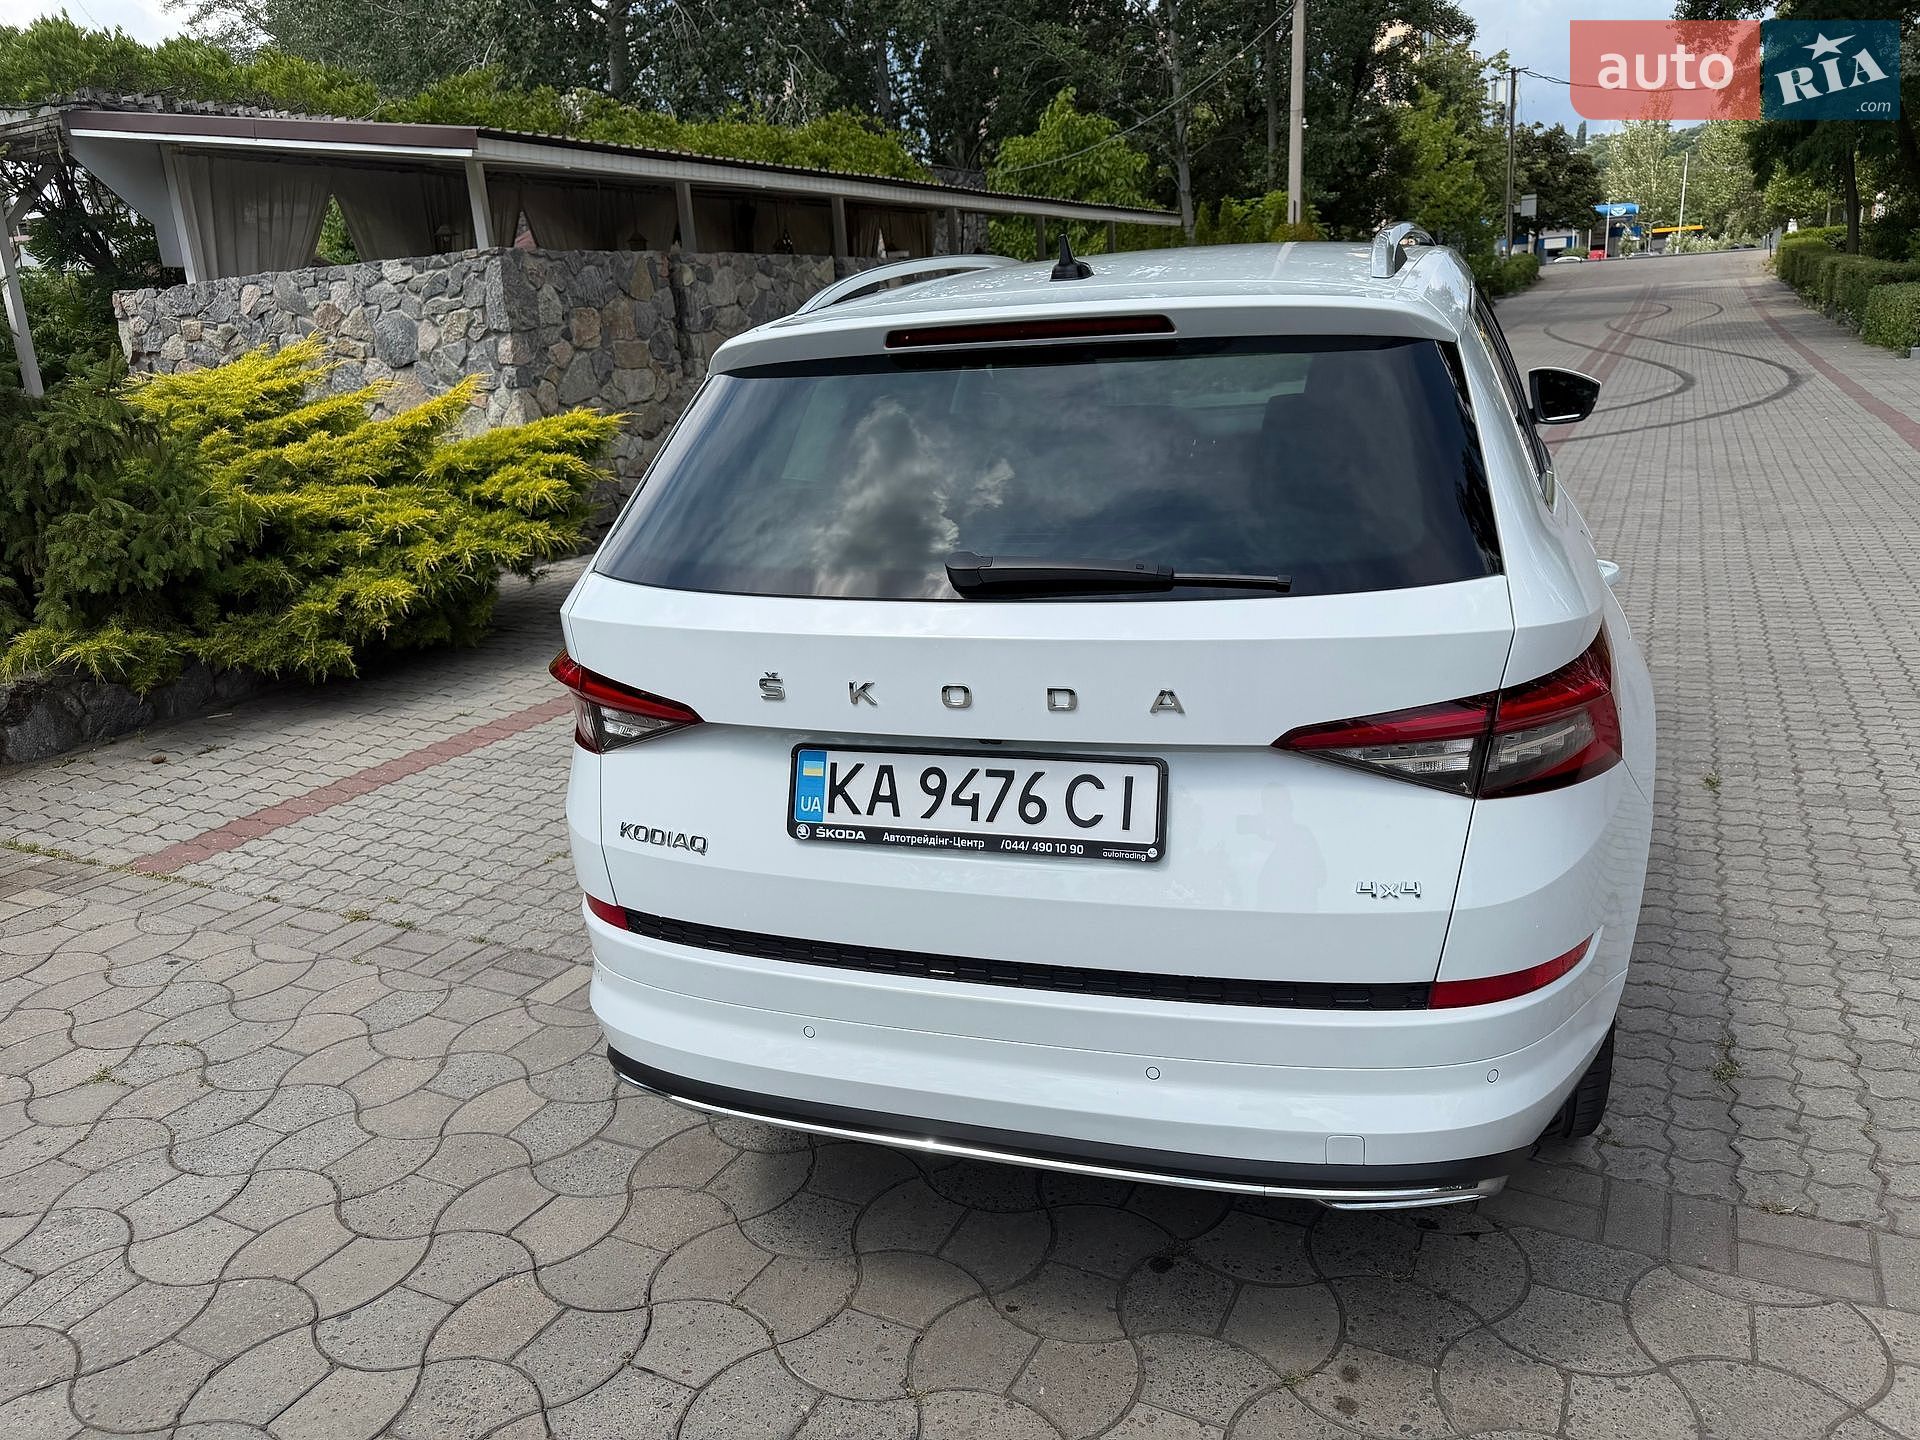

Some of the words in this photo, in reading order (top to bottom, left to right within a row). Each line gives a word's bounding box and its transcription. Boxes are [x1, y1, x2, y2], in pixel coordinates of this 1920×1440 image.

[827, 762, 901, 818] KA
[919, 766, 1048, 825] 9476
[800, 796, 821, 813] UA
[619, 821, 708, 856] KODIAQ
[816, 827, 866, 840] ŠKODA
[883, 832, 985, 850] Автотрейдінг-Центр
[1032, 842, 1053, 853] 490
[1055, 843, 1067, 853] 10
[1070, 844, 1084, 854] 90
[1102, 851, 1146, 861] autotrading
[1356, 881, 1421, 898] 4x4
